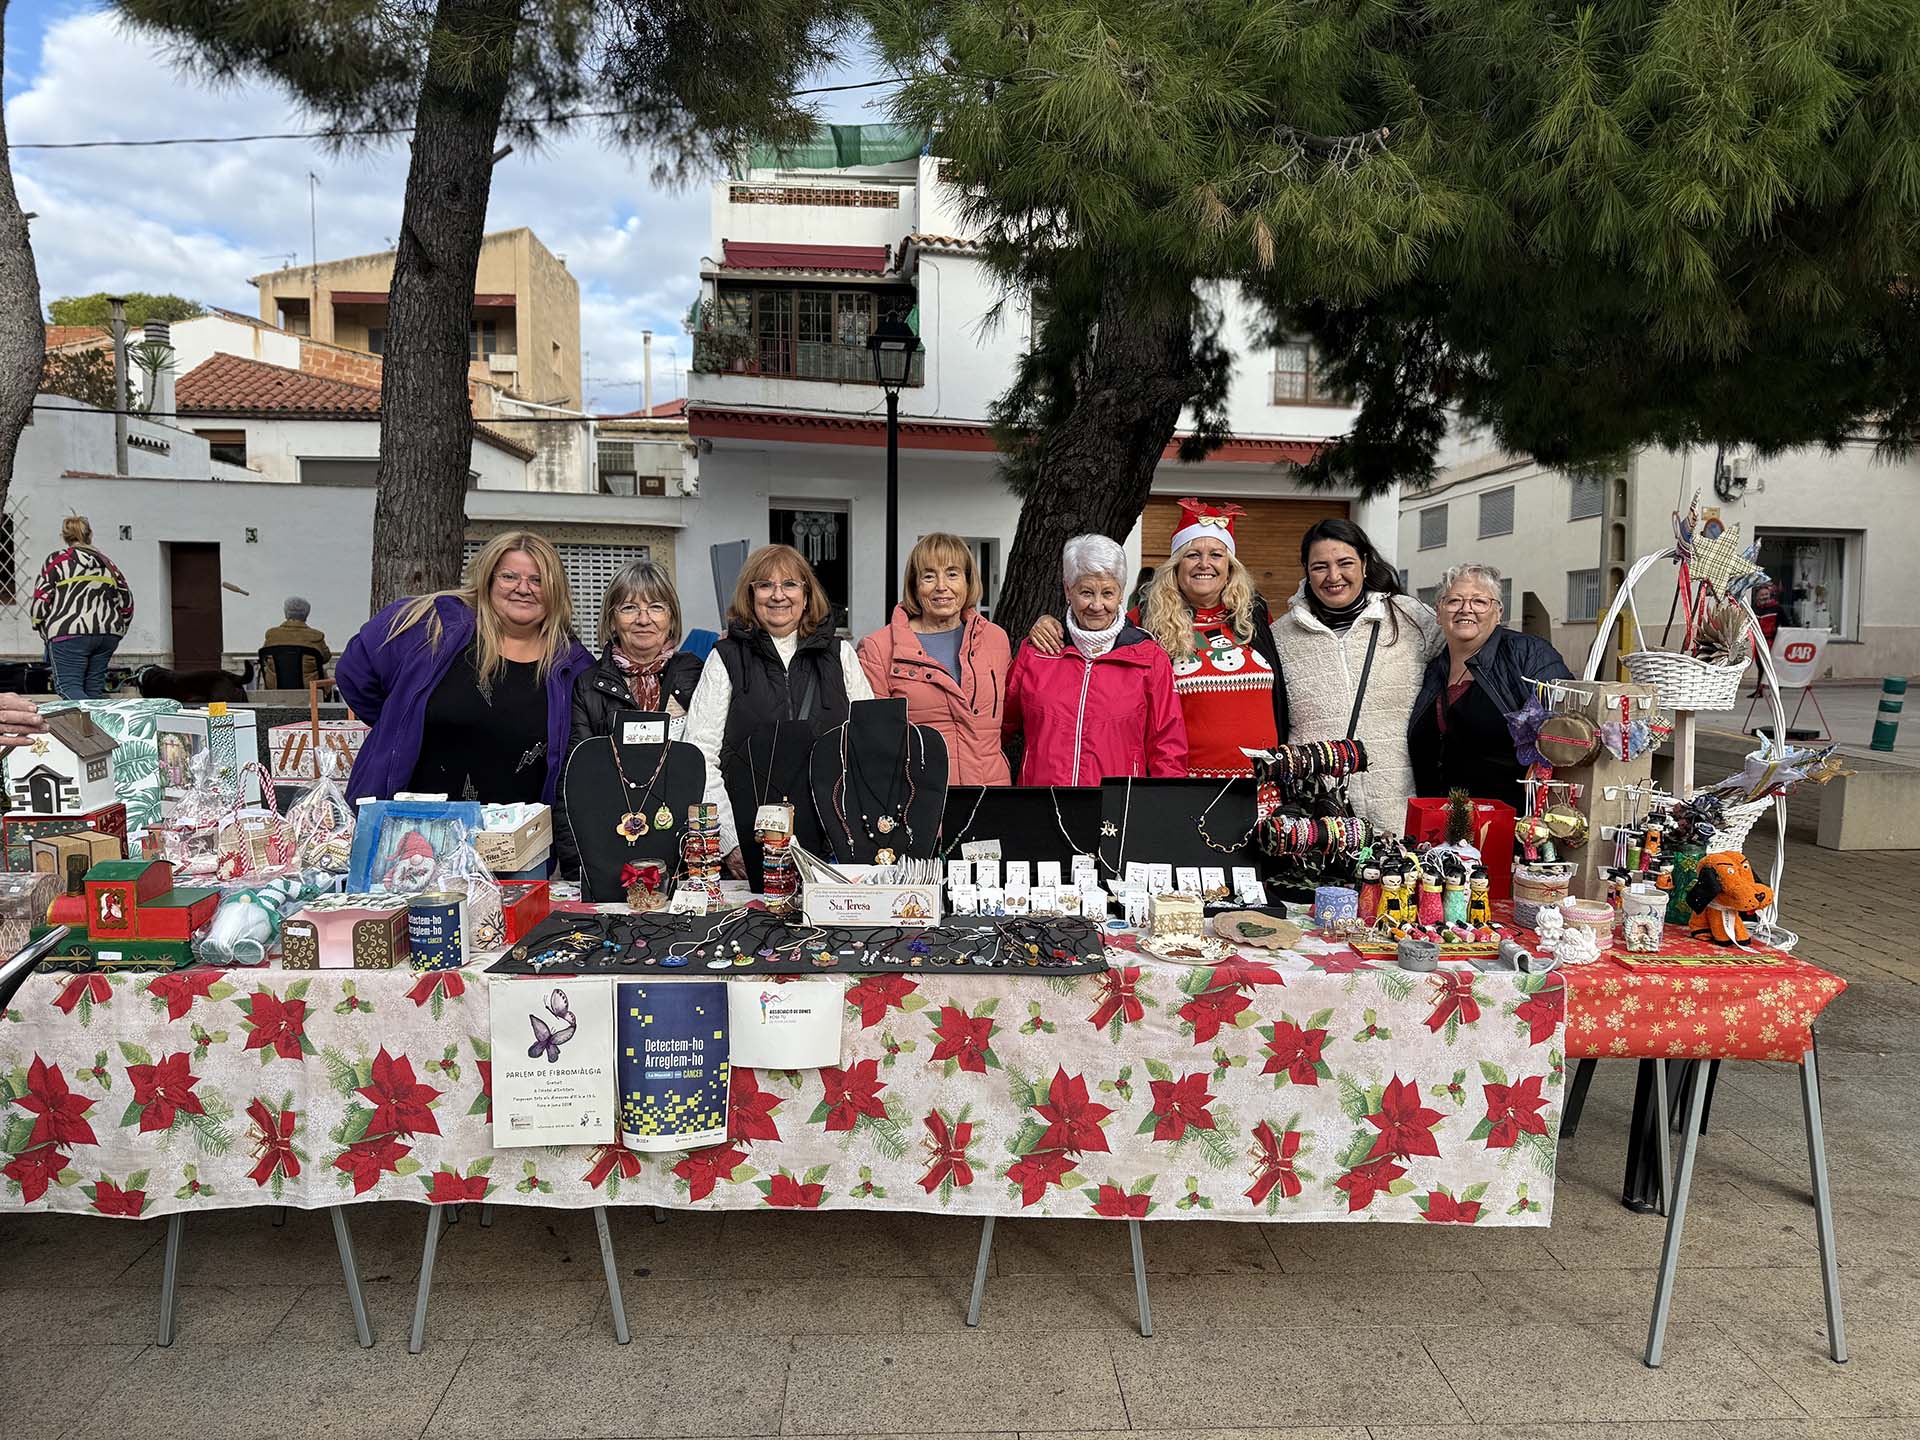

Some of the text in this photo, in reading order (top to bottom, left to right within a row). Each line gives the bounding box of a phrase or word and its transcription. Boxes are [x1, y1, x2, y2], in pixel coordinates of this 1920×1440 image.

[1788, 646, 1812, 659] JAR
[845, 899, 871, 911] Teresa
[645, 1037, 704, 1052] Detectem-ho
[645, 1052, 704, 1070] Arreglem-ho
[505, 1067, 602, 1079] PARLEM DE FIBROMIÀLGIA
